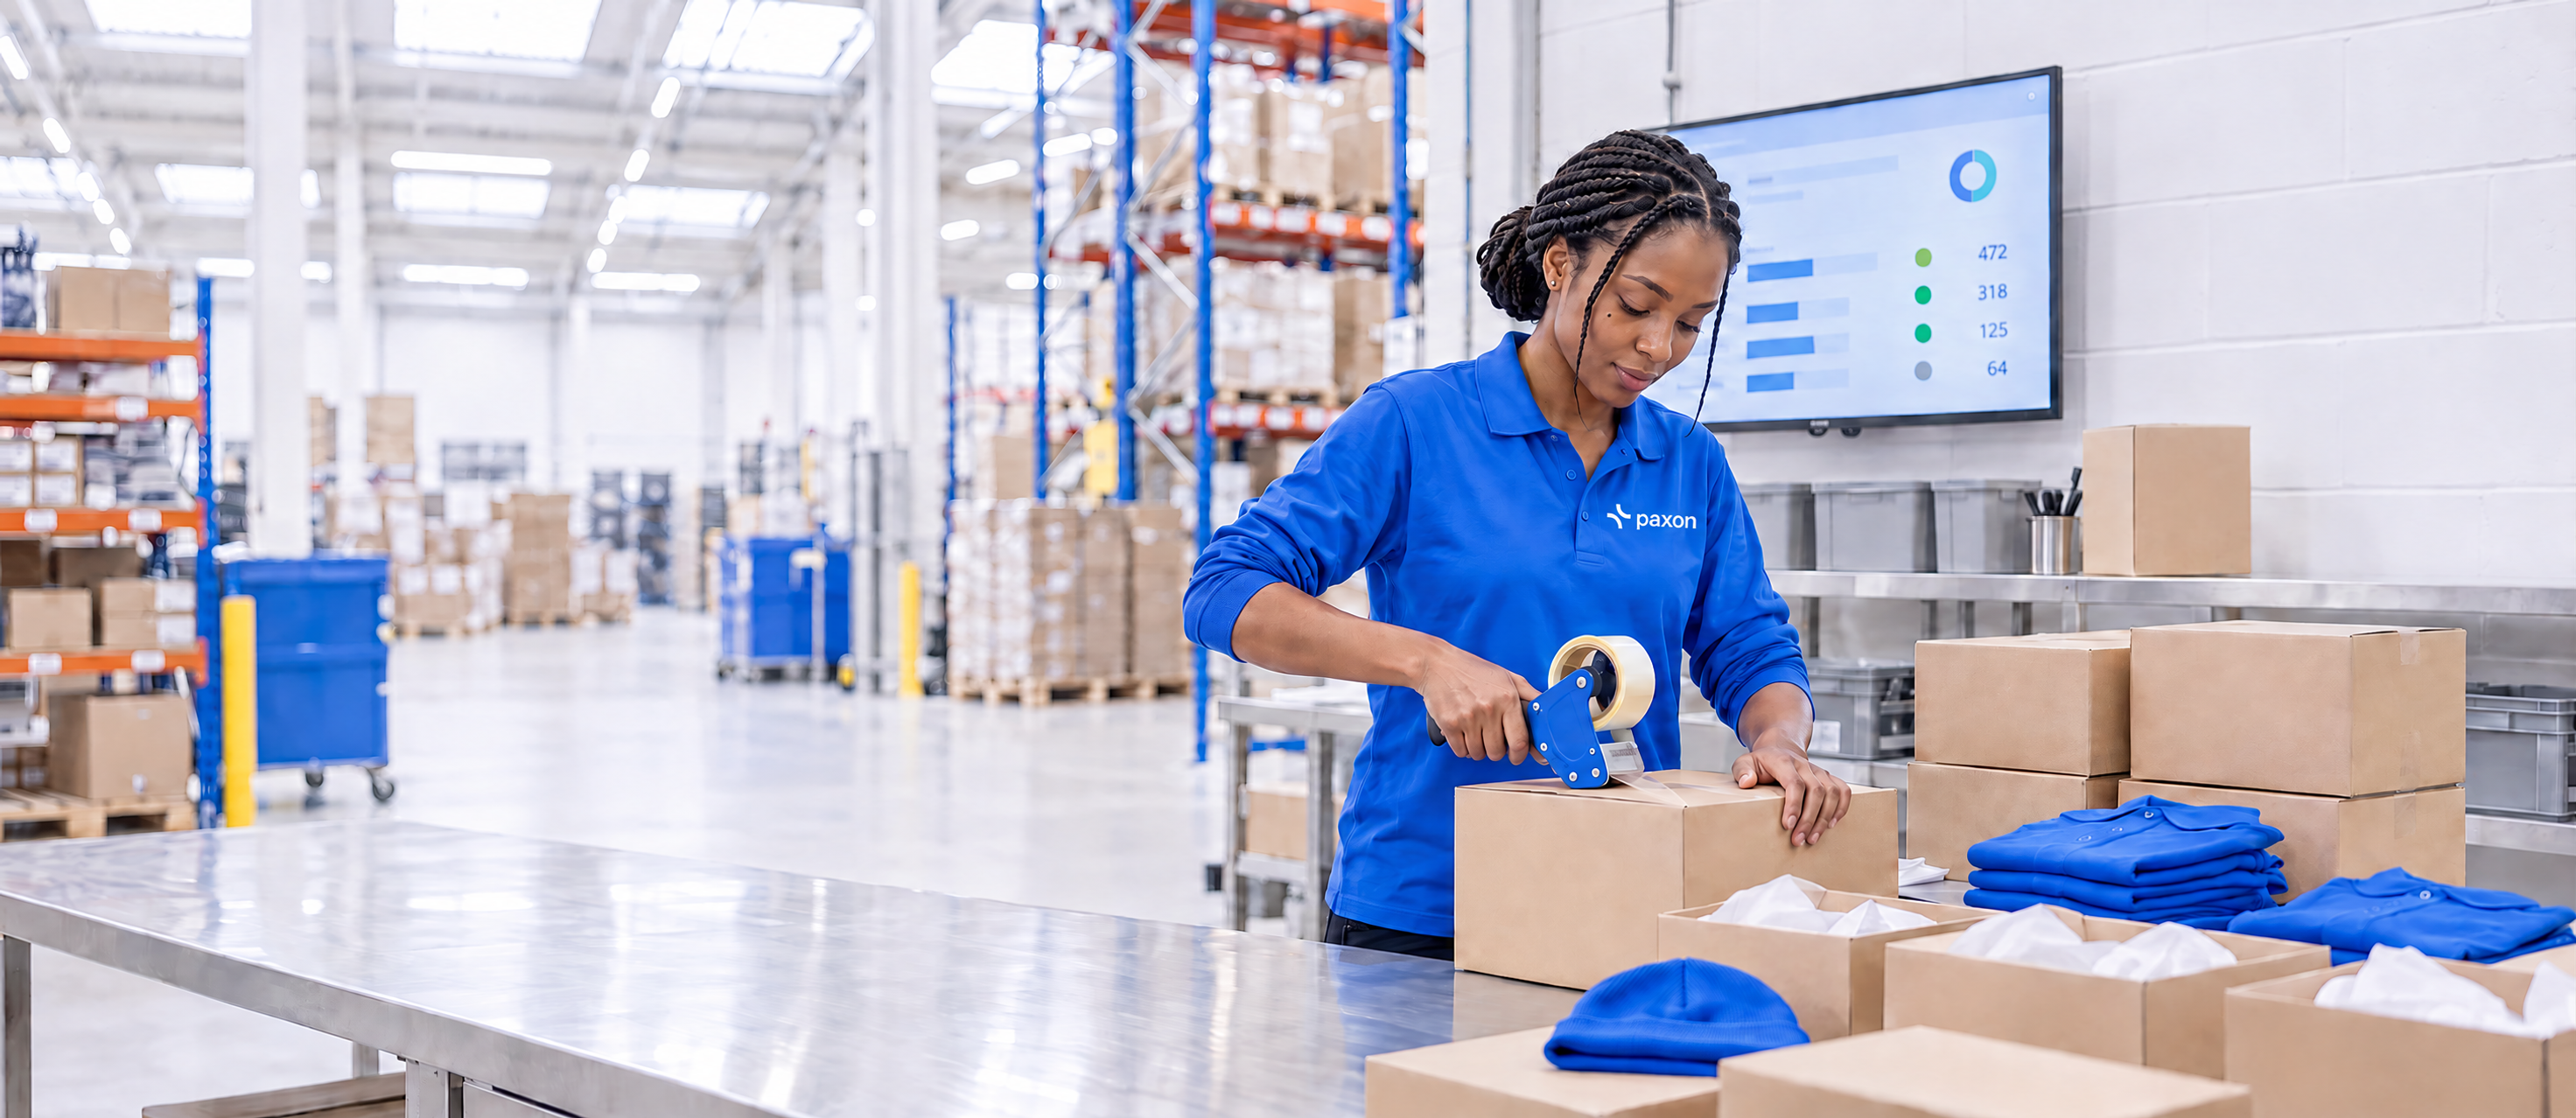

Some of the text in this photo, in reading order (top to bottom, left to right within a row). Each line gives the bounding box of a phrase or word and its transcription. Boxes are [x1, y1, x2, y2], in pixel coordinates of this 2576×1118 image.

[1978, 244, 2007, 261] 472
[1978, 283, 2007, 301] 318
[1980, 321, 2008, 339] 125
[1987, 360, 2007, 376] 64
[1636, 514, 1697, 530] paxon
